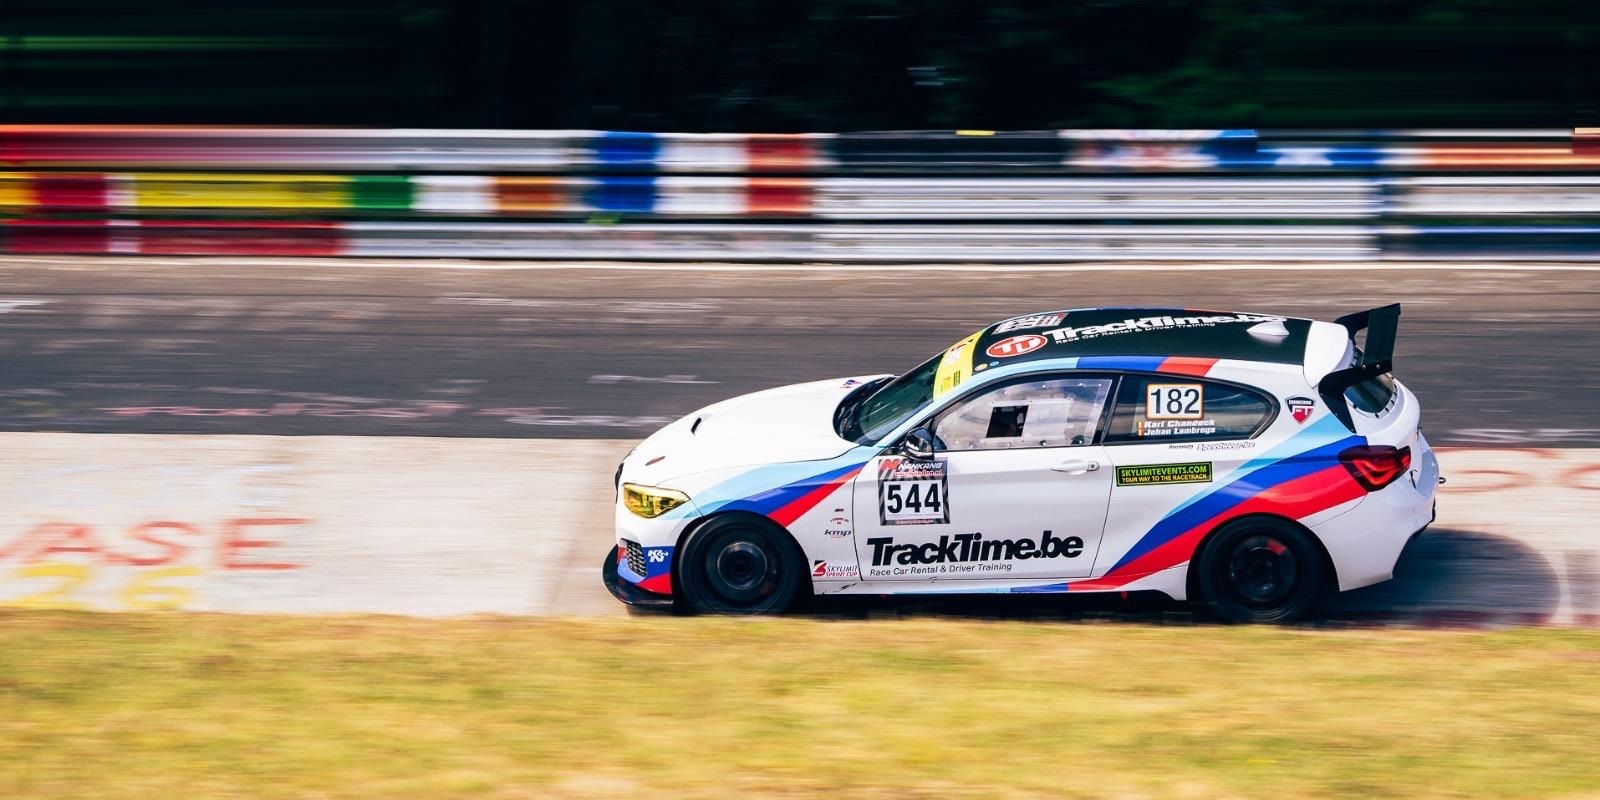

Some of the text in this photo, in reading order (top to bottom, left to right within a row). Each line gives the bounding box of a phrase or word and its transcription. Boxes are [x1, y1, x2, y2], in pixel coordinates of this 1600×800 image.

[1150, 388, 1200, 414] 182
[1121, 465, 1207, 477] SKYLIMITEVENTS.COM
[887, 483, 941, 513] 544
[866, 530, 1084, 567] TrackTime.be
[870, 568, 891, 577] Race
[893, 567, 907, 576] Car
[910, 566, 938, 574] Rental
[949, 564, 975, 573] Driver
[978, 562, 1012, 572] Training
